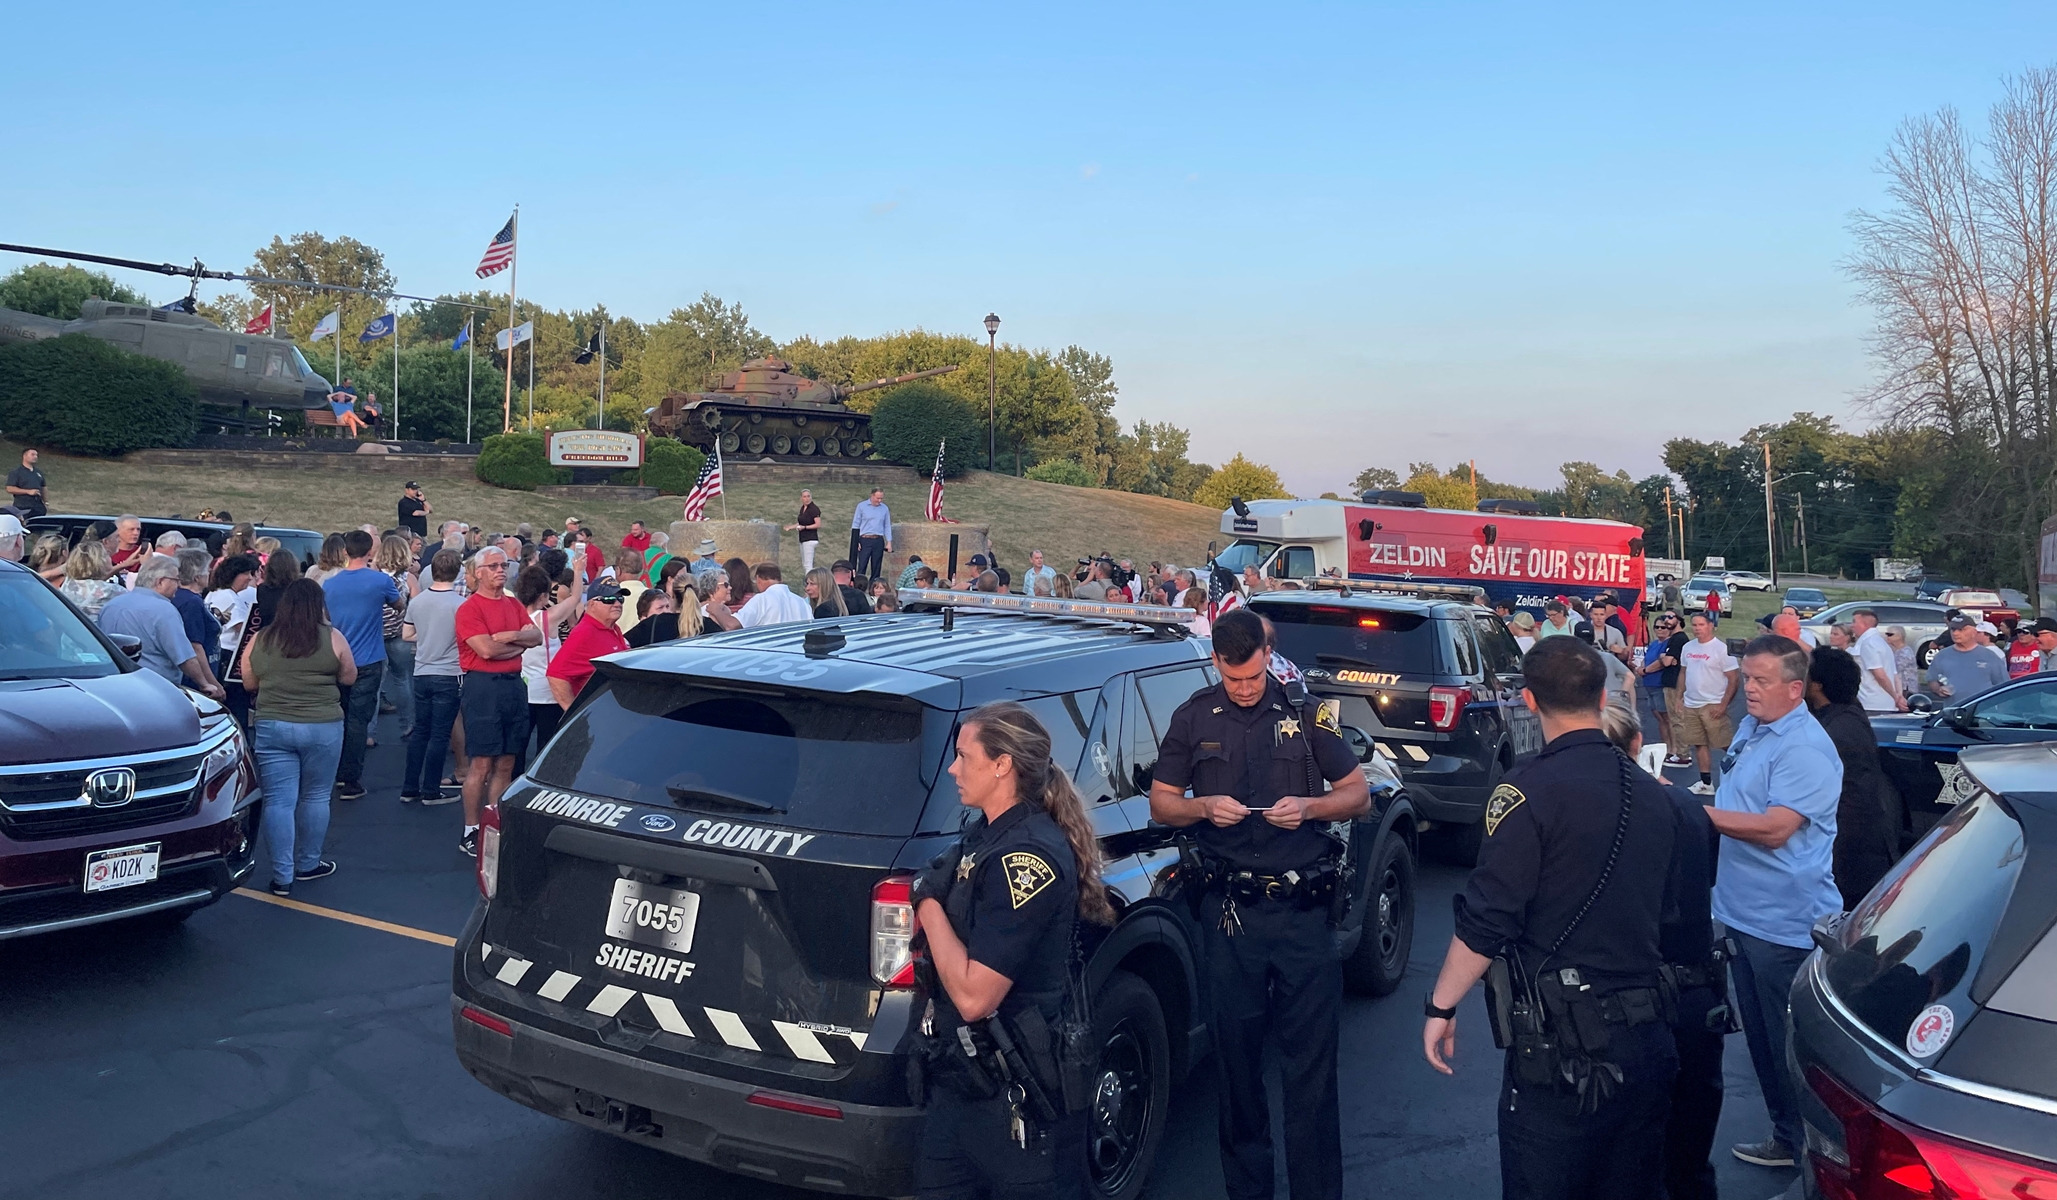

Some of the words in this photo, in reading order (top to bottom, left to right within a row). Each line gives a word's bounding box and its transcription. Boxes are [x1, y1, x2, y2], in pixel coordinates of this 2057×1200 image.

[1369, 543, 1446, 567] ZELDIN
[1469, 544, 1523, 576] SAVE
[1527, 548, 1568, 579] OUR
[1572, 551, 1631, 583] STATE
[677, 652, 849, 682] 7055
[1336, 669, 1401, 686] COUNTY
[526, 790, 632, 828] MONROE
[683, 819, 815, 856] COUNTY
[112, 857, 143, 880] KD2K
[1012, 856, 1049, 874] SHERIFF
[622, 896, 685, 935] 7055
[595, 943, 696, 984] SHERIFF
[800, 1022, 829, 1031] HYBRID
